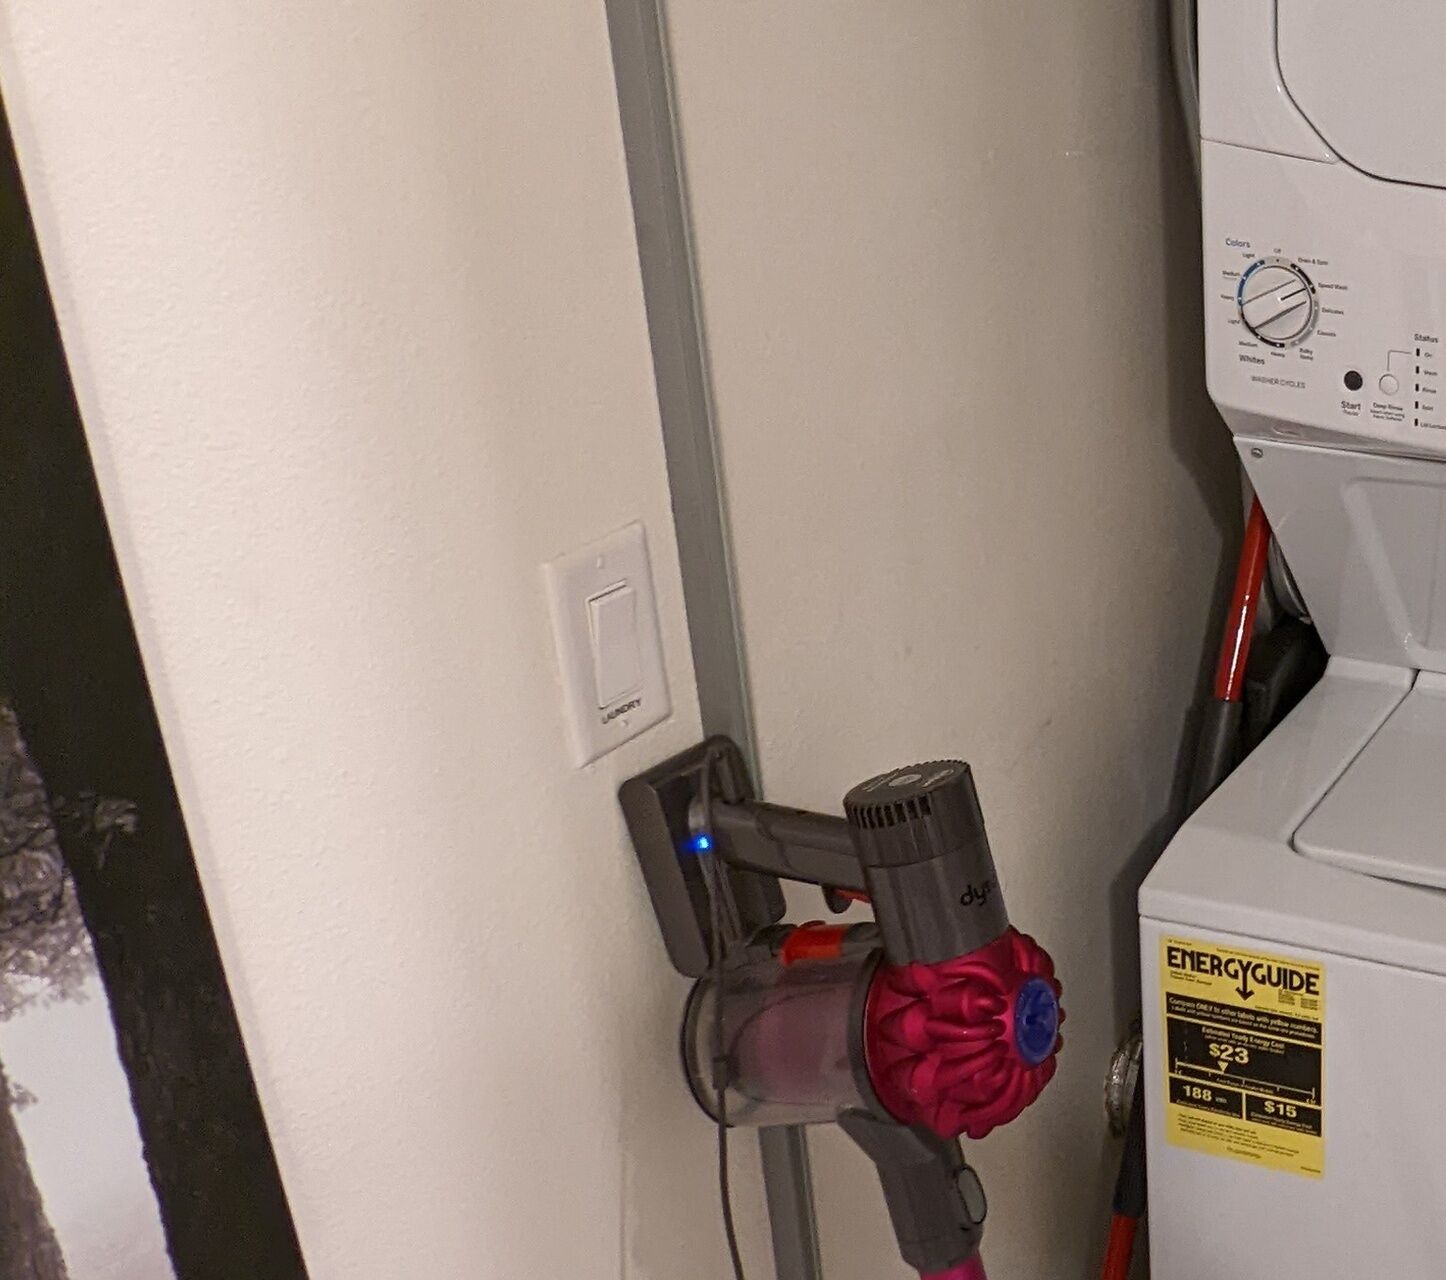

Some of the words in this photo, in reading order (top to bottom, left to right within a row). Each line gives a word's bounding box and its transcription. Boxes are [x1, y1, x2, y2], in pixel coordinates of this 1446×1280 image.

[1225, 237, 1251, 249] Colors
[1414, 333, 1439, 344] Status
[1239, 354, 1266, 366] Whites
[1341, 400, 1361, 411] Start
[602, 697, 642, 725] LAUNDRY
[1166, 945, 1320, 997] ENERGYGUIDE
[1208, 1042, 1249, 1065] $23
[1182, 1084, 1212, 1102] 188
[1263, 1100, 1298, 1118] $15
